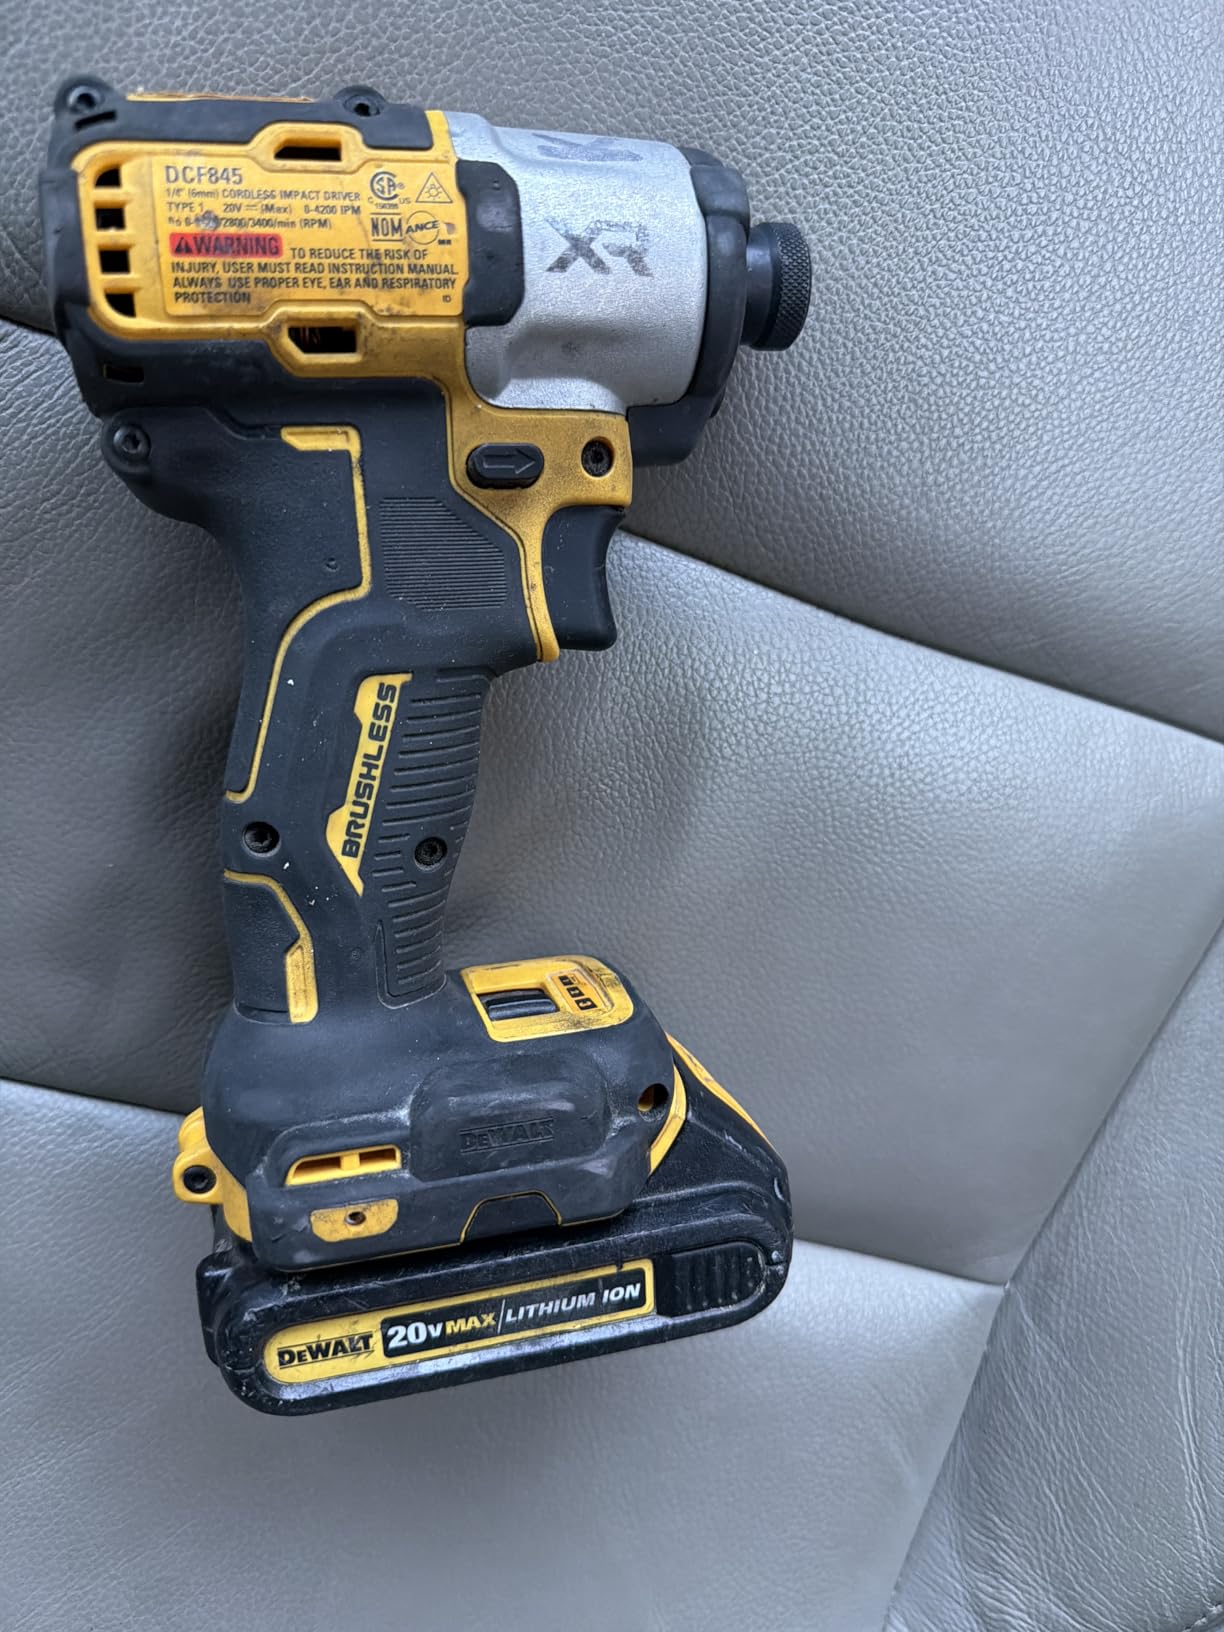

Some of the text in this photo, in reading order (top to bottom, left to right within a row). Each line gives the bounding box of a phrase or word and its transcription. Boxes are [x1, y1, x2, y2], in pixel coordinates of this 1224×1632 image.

[165, 165, 243, 185] DCF845
[188, 188, 219, 199] (6mm)
[222, 189, 276, 200] CORDLESS
[280, 190, 320, 201] IMPACT
[323, 191, 361, 202] DRIVER
[167, 202, 194, 213] TYPE
[223, 203, 242, 213] 20V
[260, 203, 293, 214] (Max)
[304, 205, 337, 215] 0-4200
[340, 205, 362, 215] IPM
[299, 218, 332, 230] (RPM)
[371, 217, 403, 237] NOM
[405, 220, 439, 234] ANCE
[193, 235, 428, 261] WARNING TO REDUCE THE RISK OF
[545, 217, 654, 278] XR
[171, 261, 220, 274] INJURY,
[223, 262, 253, 274] USER
[257, 262, 291, 274] MUST
[294, 262, 325, 274] READ
[328, 262, 404, 275] INSTRUCTION
[173, 277, 456, 290] ALWAYS USE PROPER EYE, EAR AND RESPIRATORY
[175, 291, 252, 304] PROTECTION
[341, 682, 397, 858] BRUSHLESS
[277, 1333, 374, 1367] DEWALT
[445, 1311, 497, 1336] MAX
[504, 1292, 597, 1324] LITHIUM
[601, 1282, 642, 1304] ION
